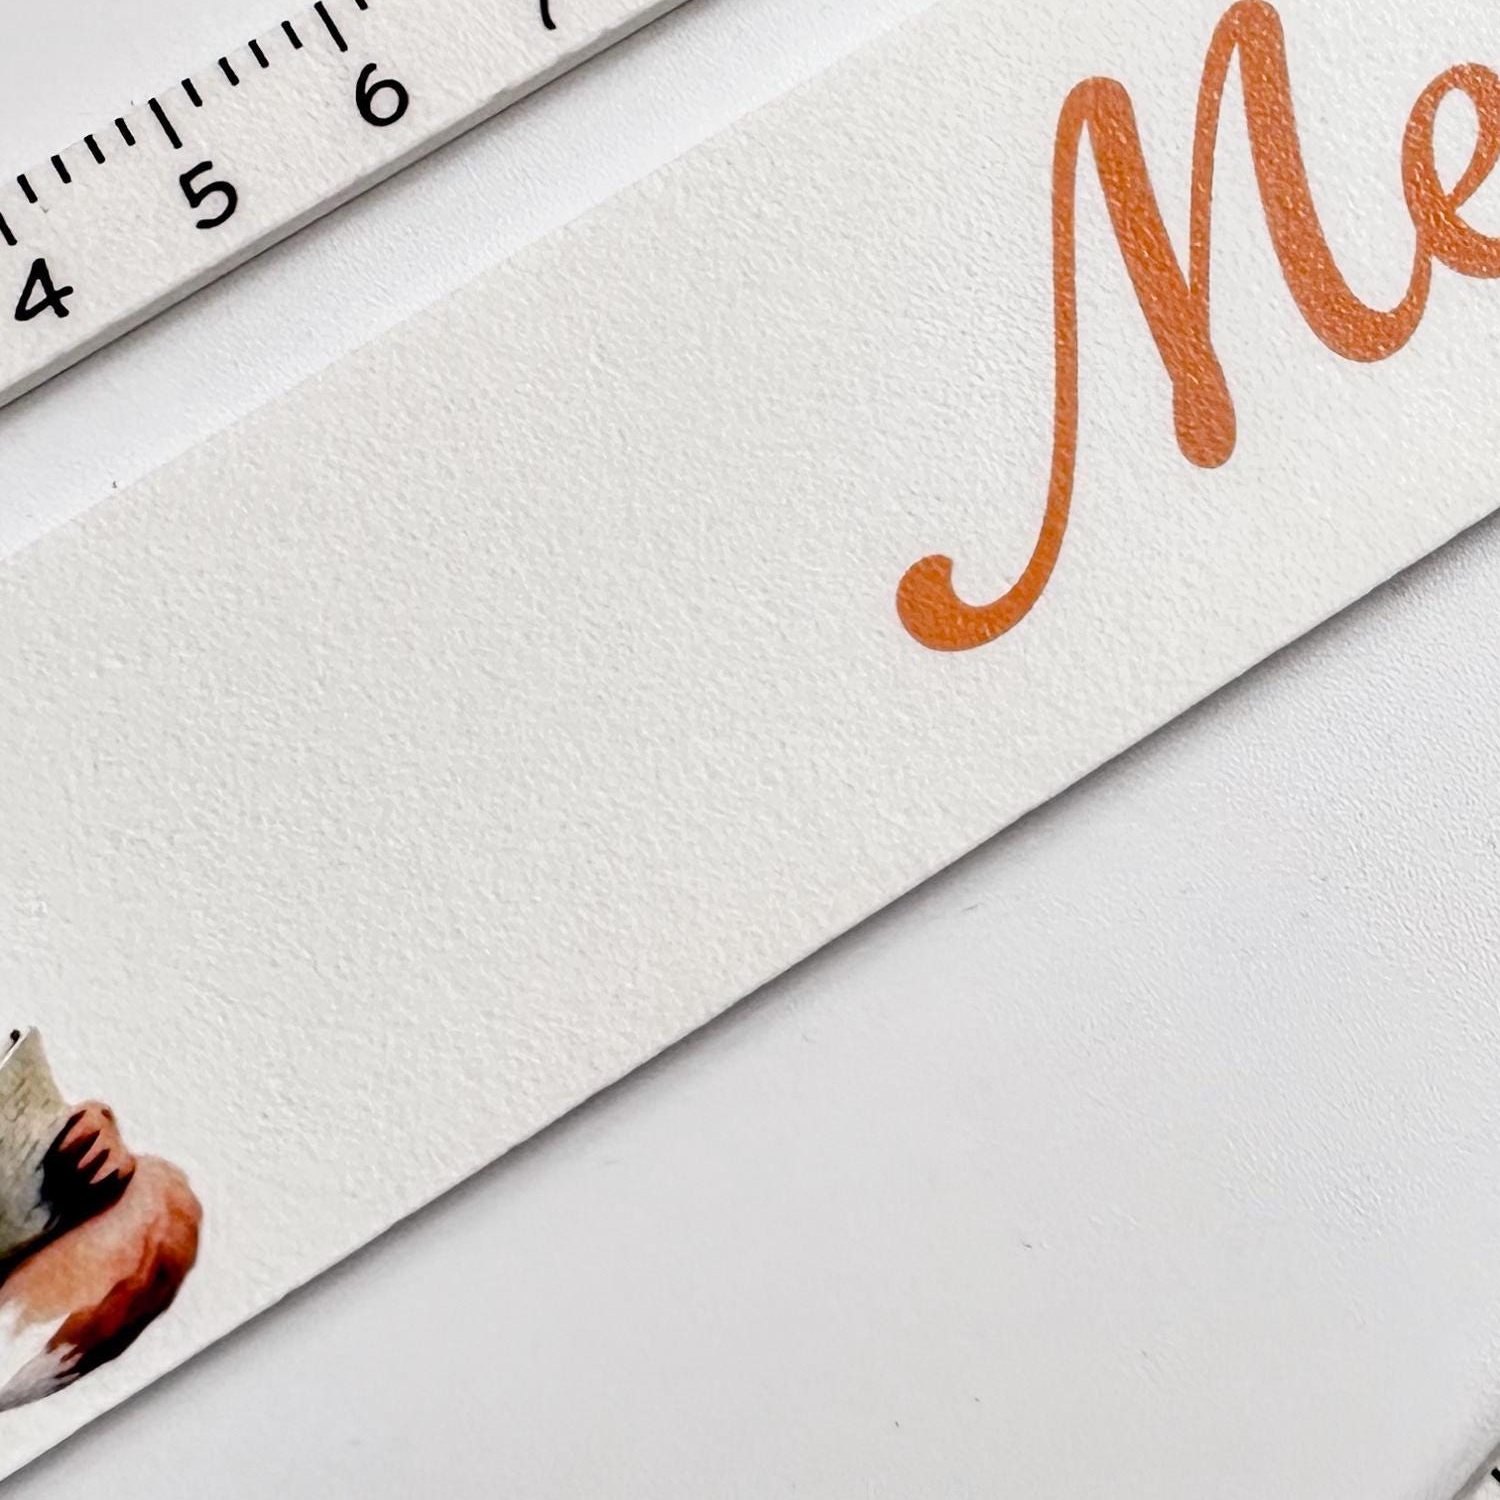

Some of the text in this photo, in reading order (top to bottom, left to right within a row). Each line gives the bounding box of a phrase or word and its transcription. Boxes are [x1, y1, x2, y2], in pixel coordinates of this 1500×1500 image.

[13, 256, 75, 323] 4
[177, 159, 240, 231] 5
[354, 61, 411, 129] 6
